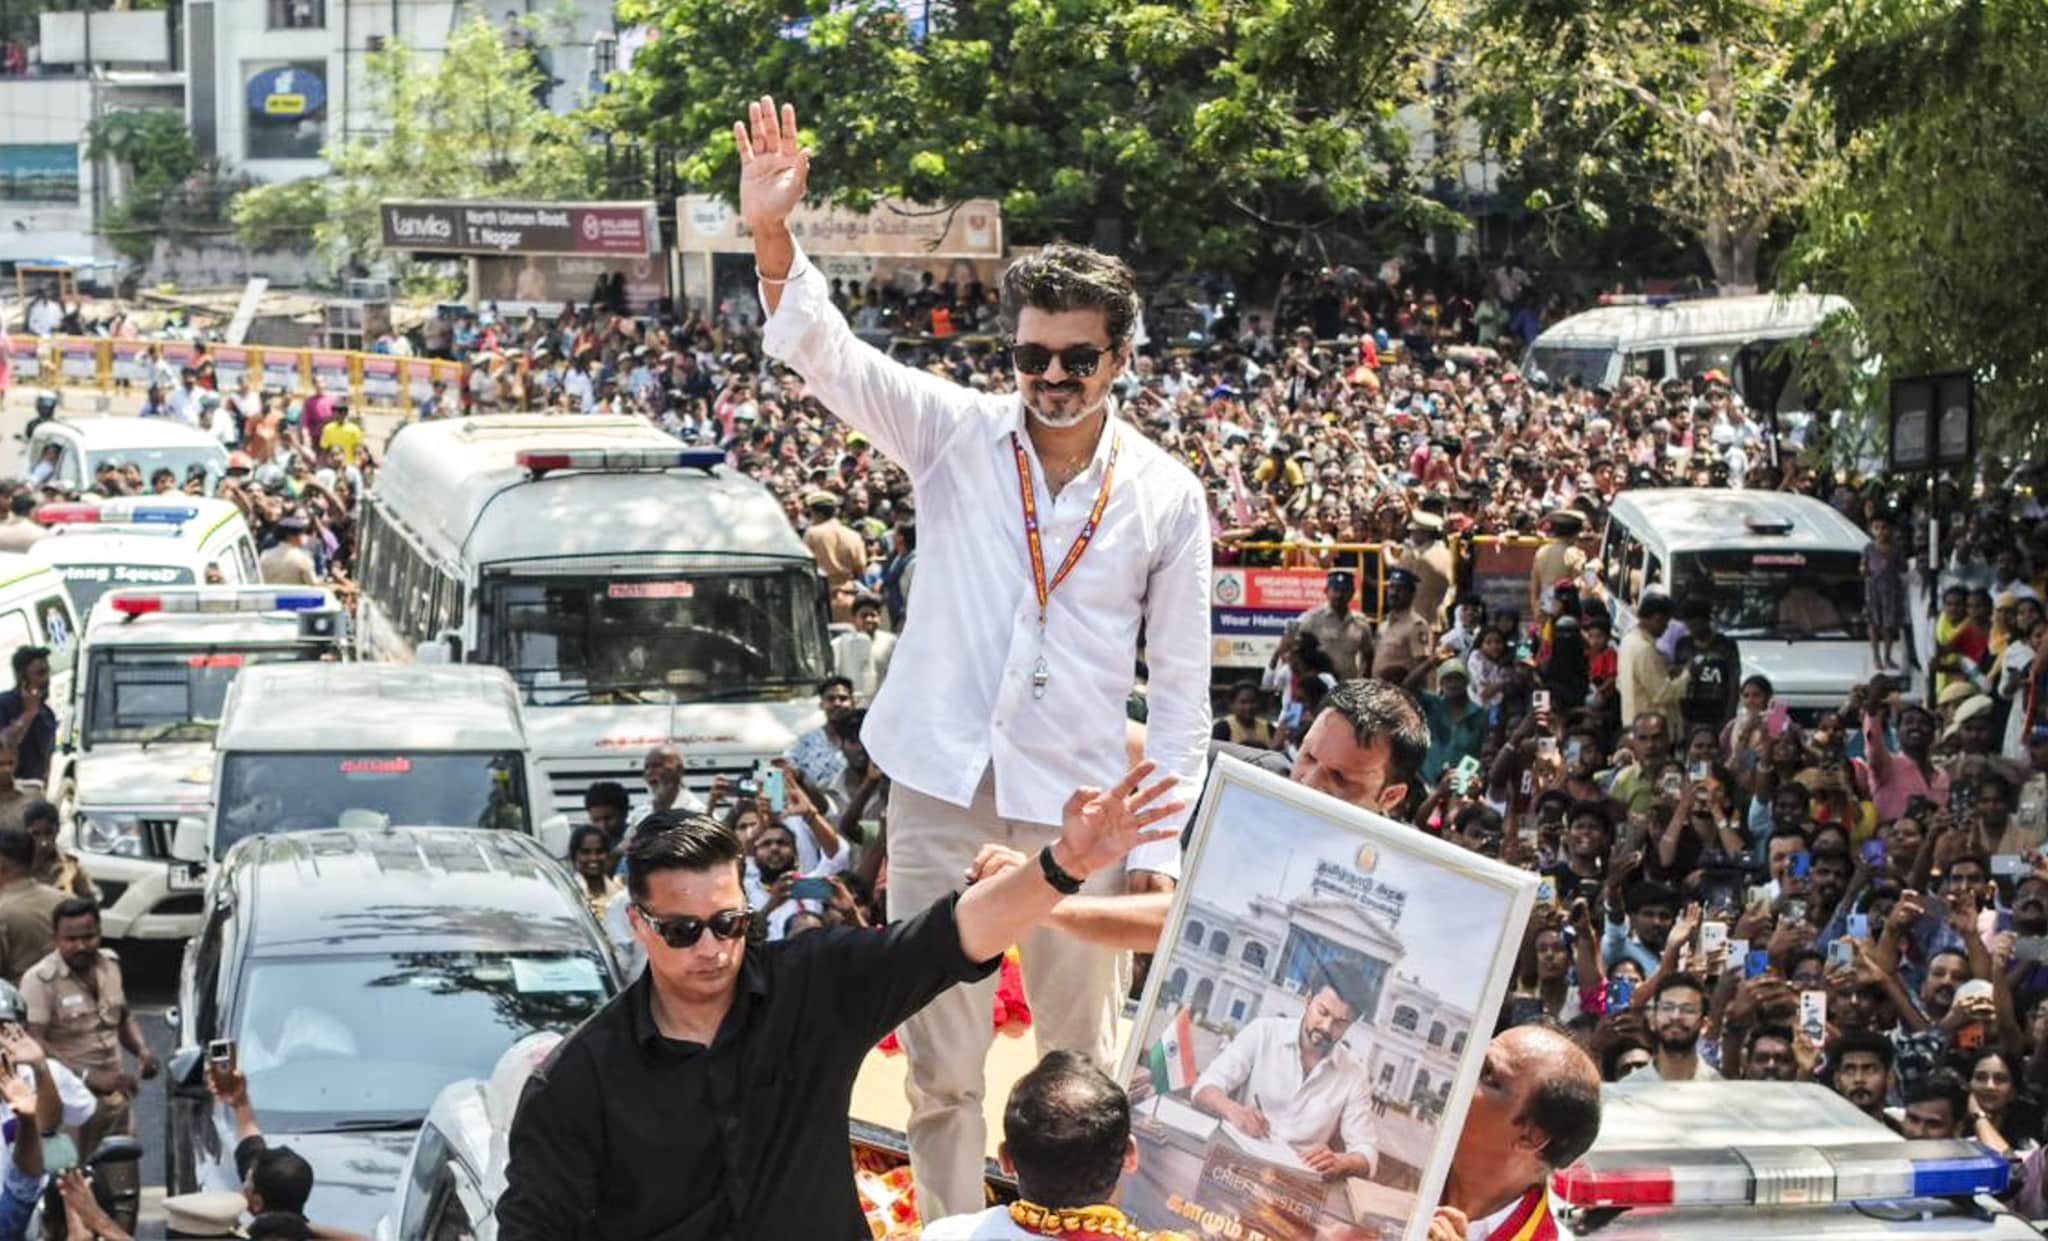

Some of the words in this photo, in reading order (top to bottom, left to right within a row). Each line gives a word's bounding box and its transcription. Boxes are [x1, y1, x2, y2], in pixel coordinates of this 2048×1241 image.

[466, 210, 497, 225] North
[482, 229, 521, 250] Nagar
[1220, 613, 1251, 627] Wear
